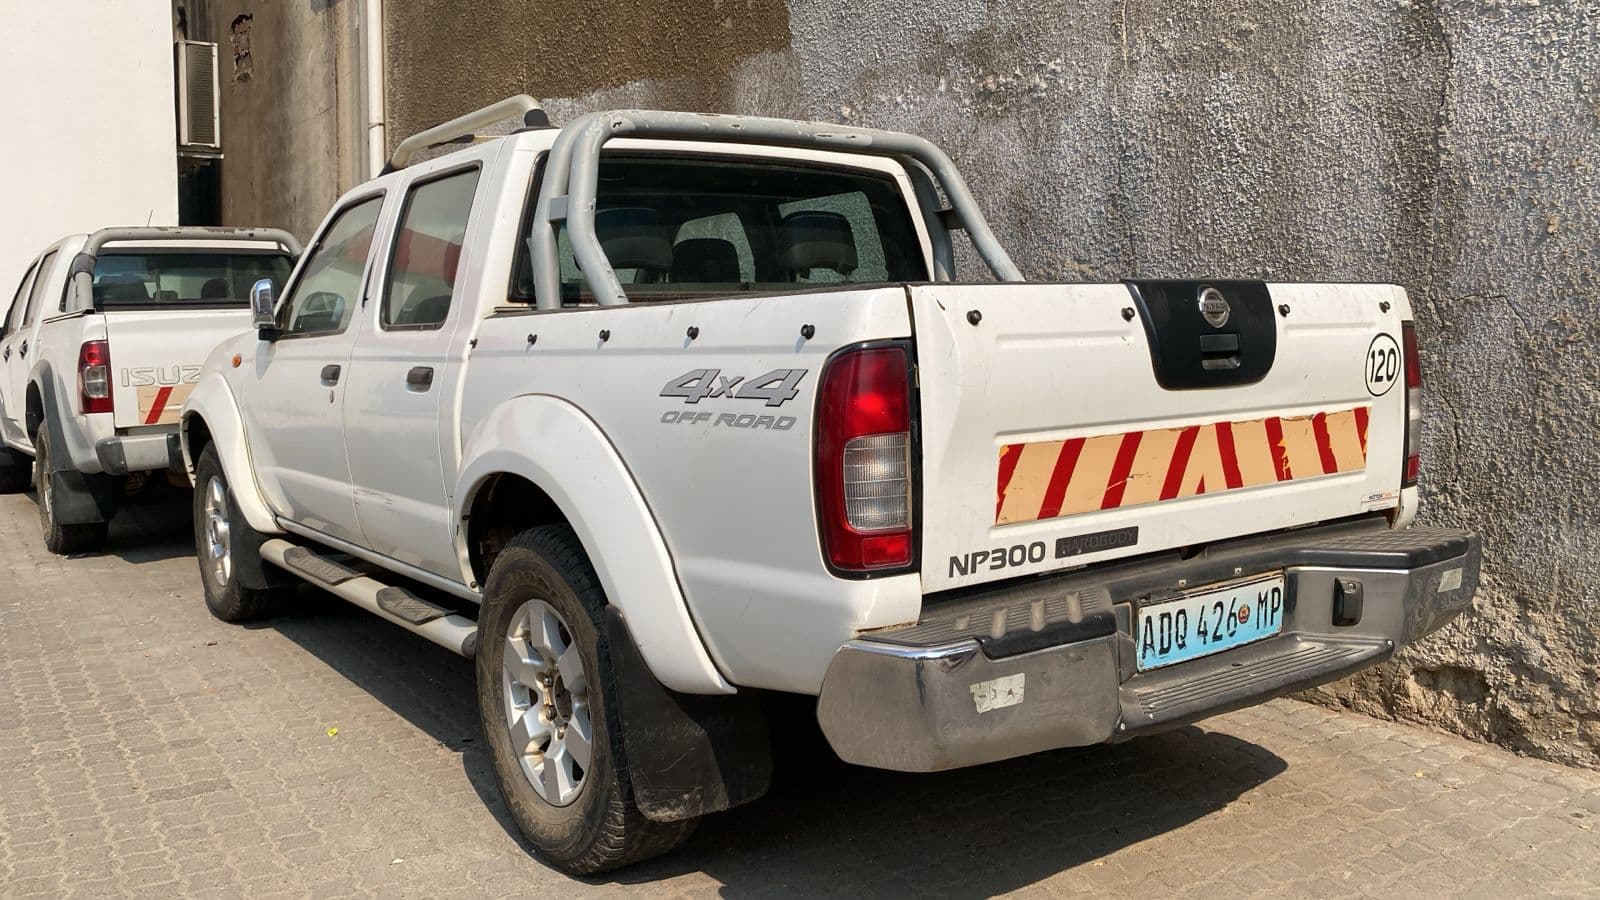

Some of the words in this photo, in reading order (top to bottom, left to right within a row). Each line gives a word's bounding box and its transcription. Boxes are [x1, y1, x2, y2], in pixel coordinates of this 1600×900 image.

[120, 364, 203, 387] ISUZ
[1370, 347, 1397, 383] 120
[659, 368, 808, 407] 4x4
[660, 411, 713, 425] OFF
[713, 413, 798, 431] ROAD
[948, 541, 1046, 578] NP300
[1141, 608, 1188, 660] ADQ
[1197, 596, 1238, 645] 426
[1256, 586, 1281, 630] MP
